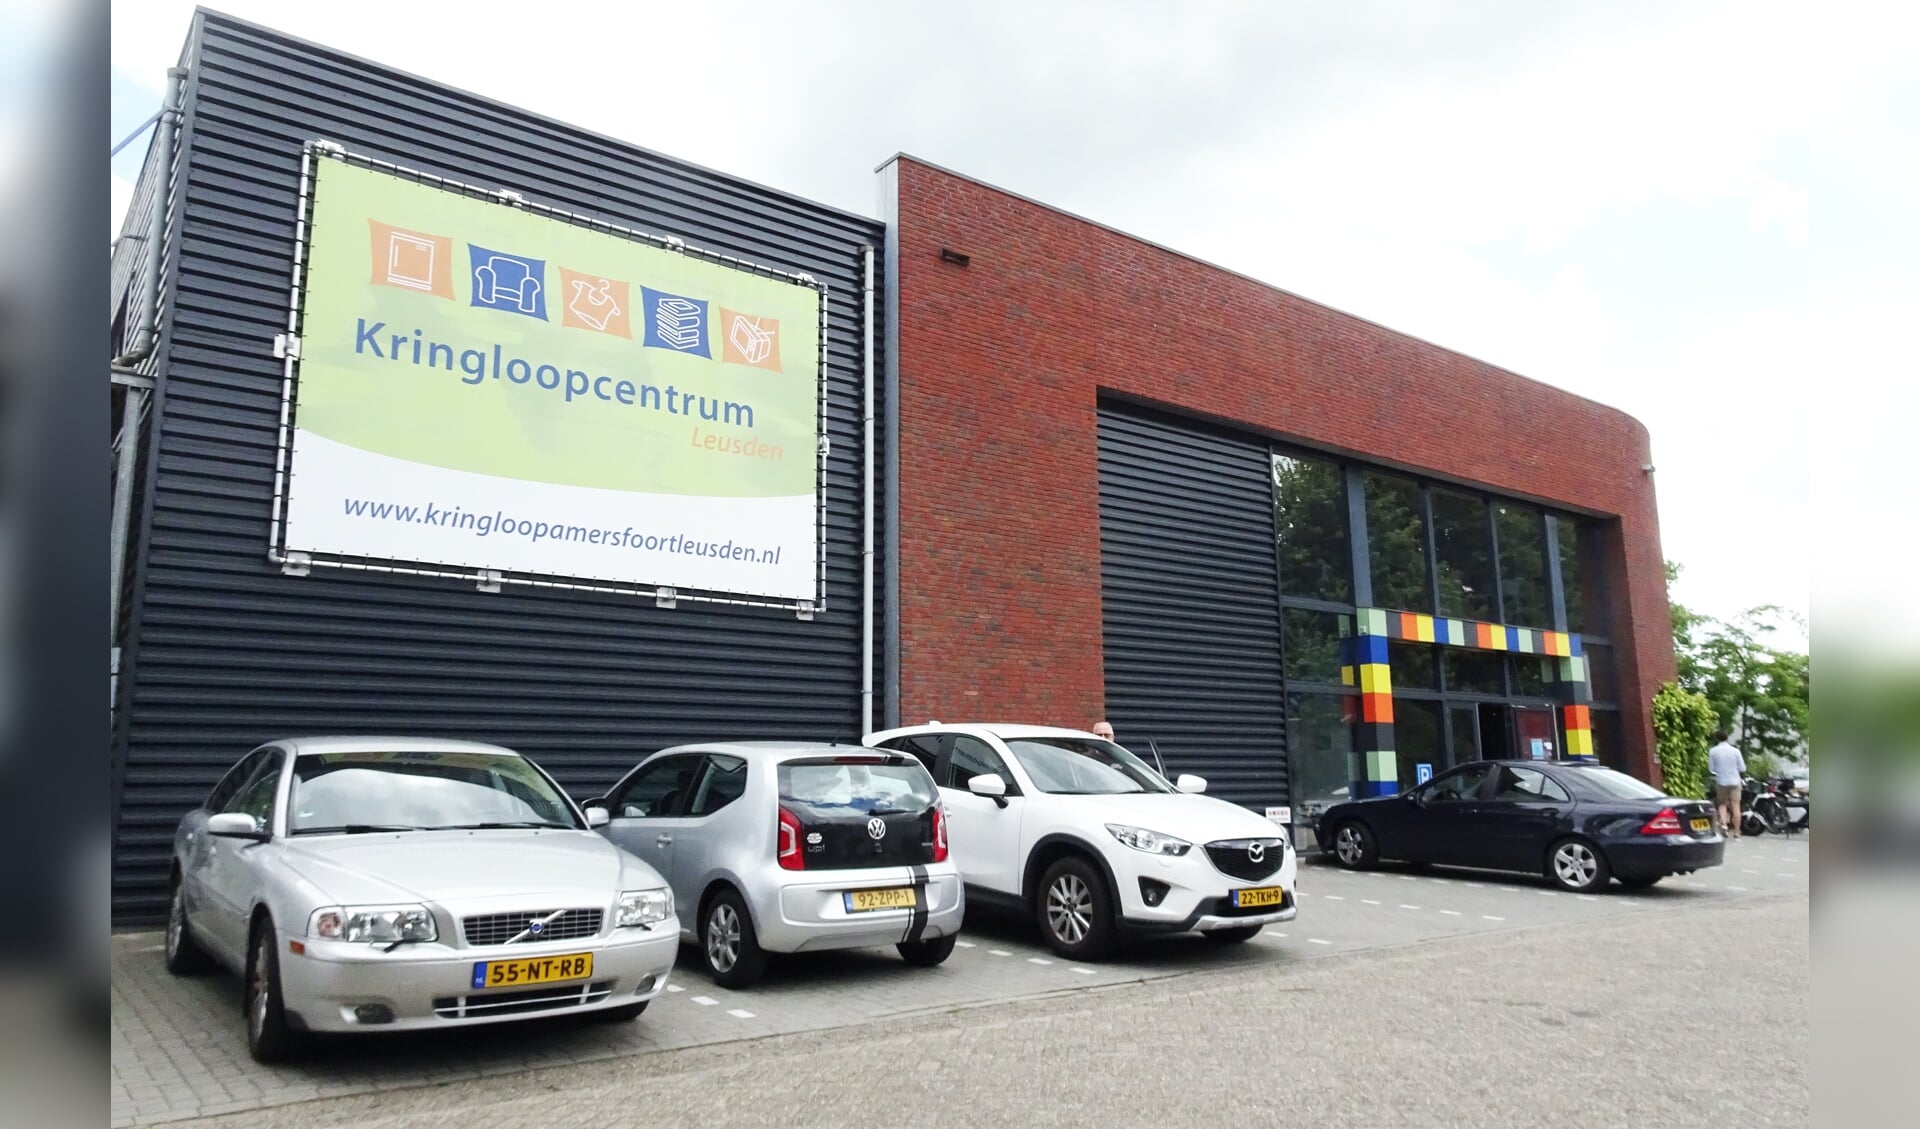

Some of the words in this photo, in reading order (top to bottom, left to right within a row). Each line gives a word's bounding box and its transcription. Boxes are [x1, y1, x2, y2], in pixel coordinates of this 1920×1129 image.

[355, 318, 754, 428] Kringloopcentrum
[691, 426, 785, 462] Leusden
[344, 498, 781, 565] www.kringloopamersfoortleusden.nl
[858, 890, 911, 907] 92-ZPP-1
[1241, 889, 1280, 905] 22-TKH-9
[492, 957, 585, 983] 55-NT-RB
